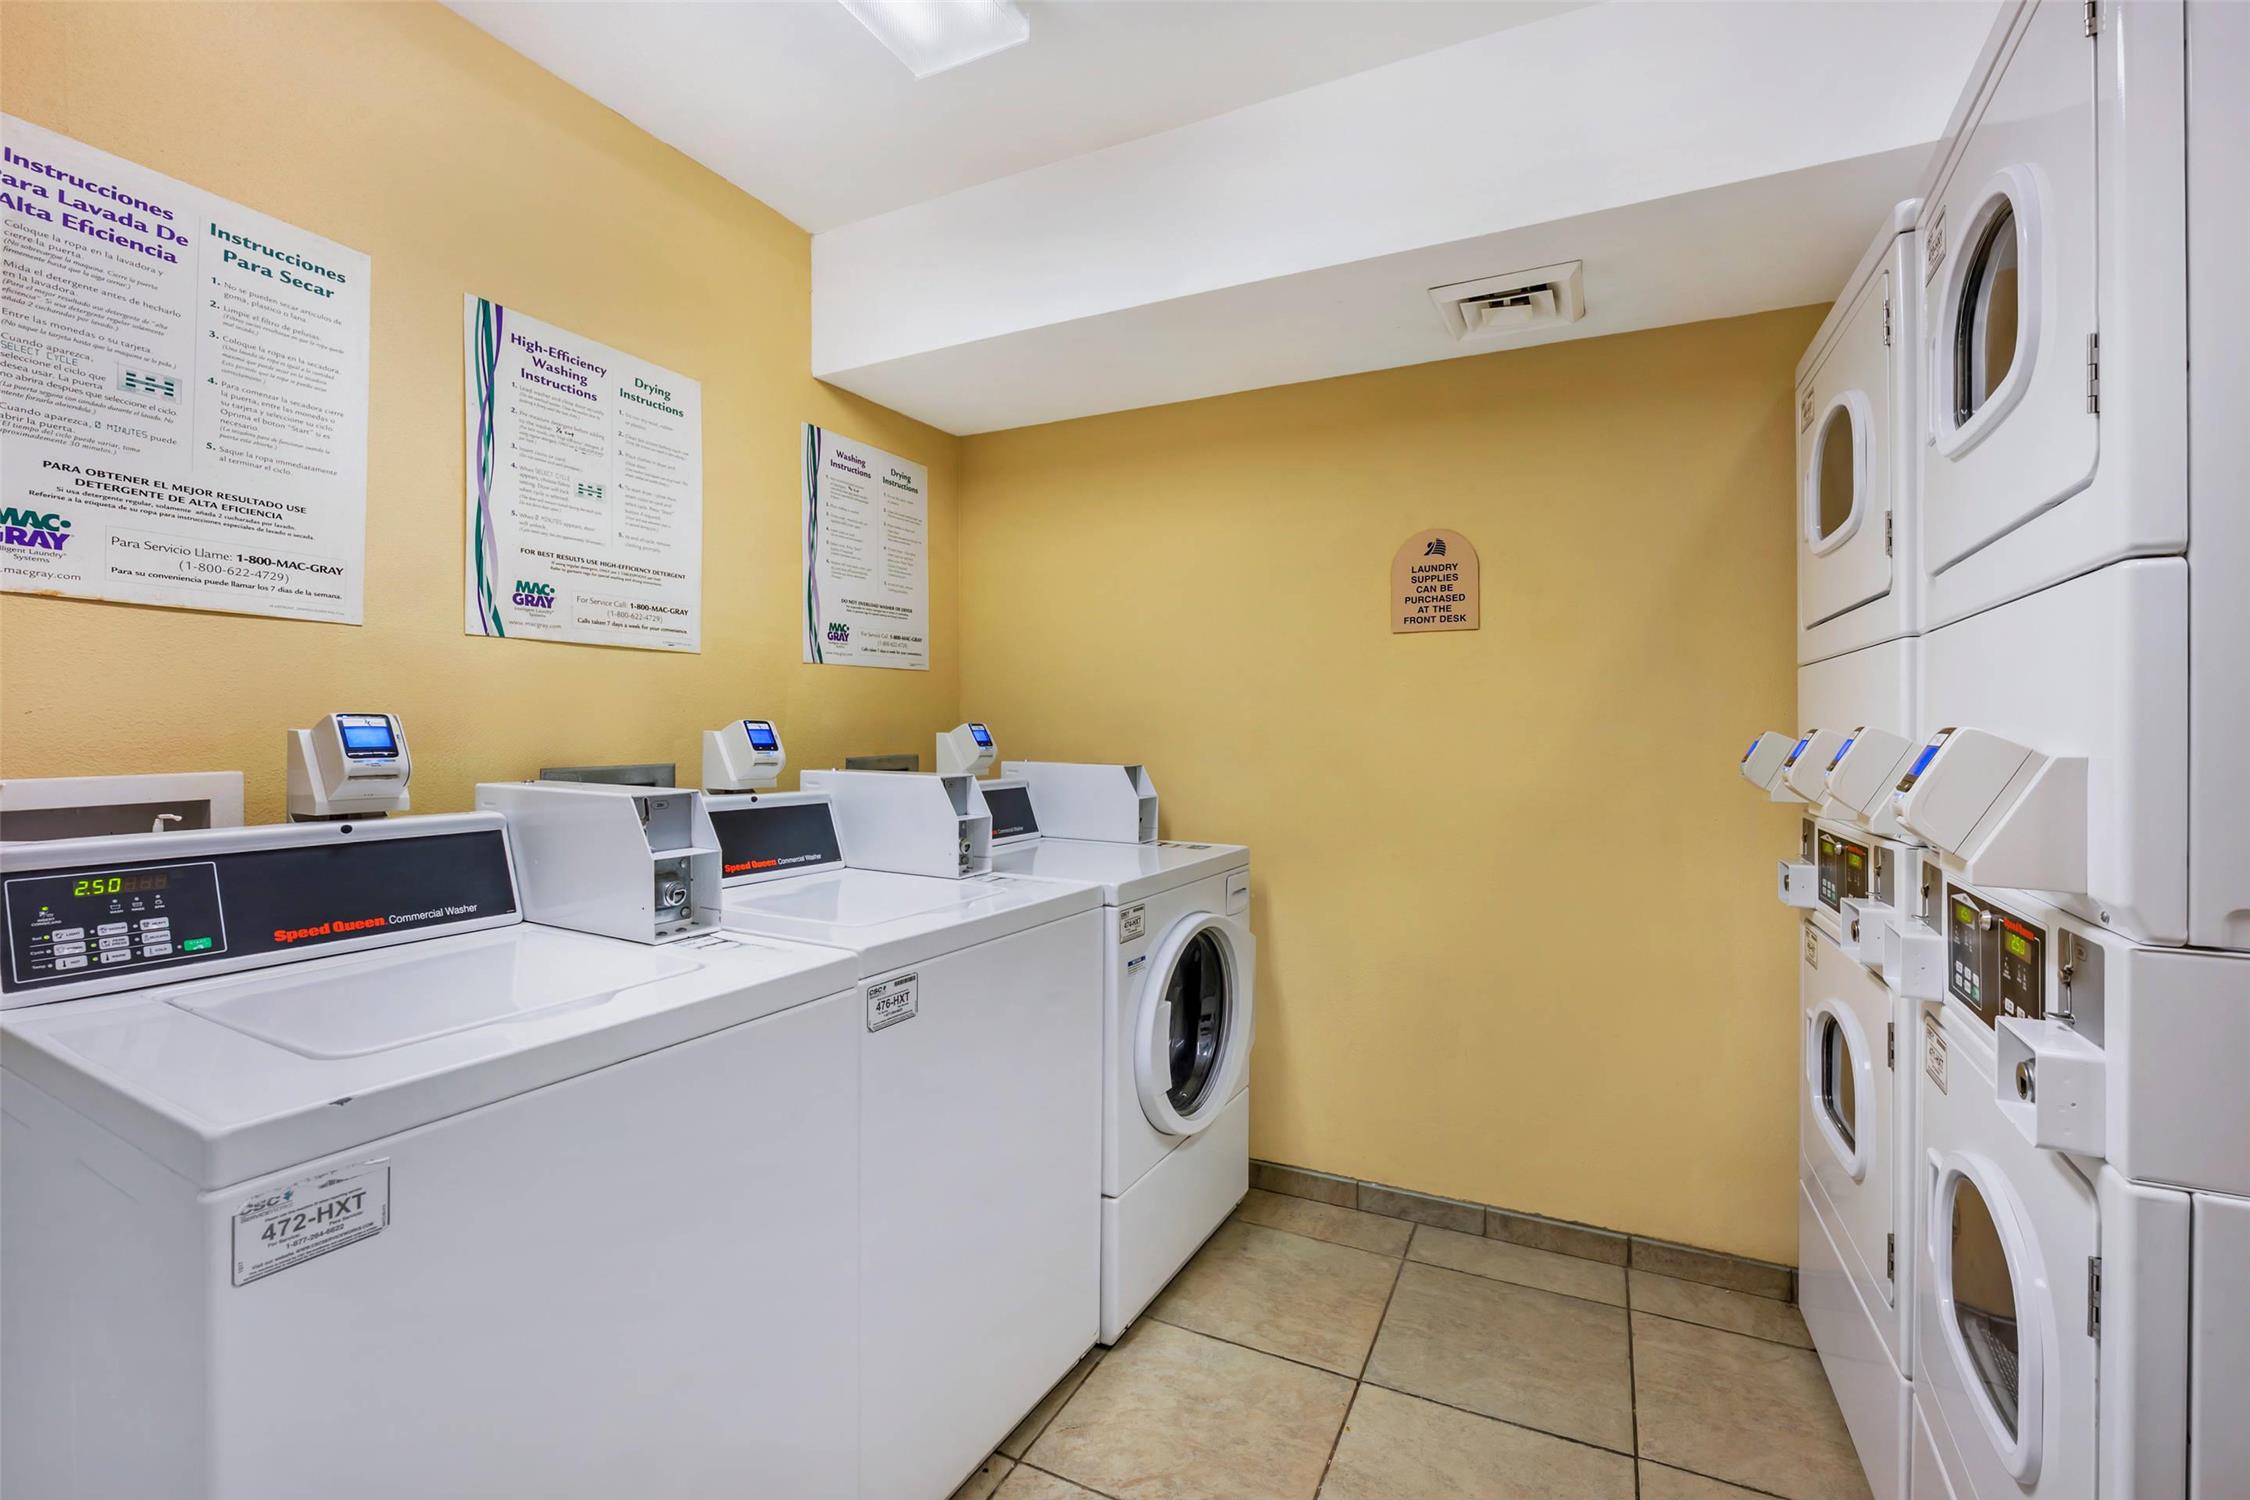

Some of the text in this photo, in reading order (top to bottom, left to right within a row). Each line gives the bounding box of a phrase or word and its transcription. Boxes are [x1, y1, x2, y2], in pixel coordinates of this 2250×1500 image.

[4, 146, 173, 220] Instrucciones
[0, 171, 188, 246] ara Lavada De
[0, 192, 176, 263] Alta Eficiencia
[210, 222, 345, 283] Instrucciones
[211, 276, 220, 285] 1.
[223, 249, 334, 298] Para Secar
[2, 258, 181, 317] Mida el detergente antes de hecharlo
[209, 299, 220, 309] 2.
[208, 330, 219, 339] 3.
[0, 339, 78, 366] SELECT CYCLE
[510, 332, 606, 376] High-Efficiency
[207, 376, 217, 385] 4.
[532, 355, 587, 386] Washing
[520, 367, 597, 401] Instructions
[634, 377, 670, 401] Drying
[619, 387, 683, 417] Instructions
[205, 441, 216, 450] 5.
[830, 458, 871, 478] Instructions
[835, 449, 866, 468] Washing
[42, 460, 305, 513] PARA OBTENER EL MEJOR RESULTADO USE
[882, 476, 918, 494] Instructions
[890, 468, 911, 484] Drying
[74, 478, 282, 520] DETERGENTE DE ALTA EFICIENCIA
[0, 525, 69, 550] RAY
[111, 535, 343, 575] Para Servicio Llame: 1-800-MAC-GRAY
[520, 547, 535, 555] FOR
[536, 550, 554, 558] BEST
[555, 553, 584, 563] RESULTS
[599, 560, 650, 573] HIGH-EFFICIENCY
[651, 569, 685, 579] DETERGENT
[178, 560, 289, 584] (1-800-622-4729)
[1411, 563, 1458, 573] LAUNDRY
[1411, 573, 1458, 583] SUPPLIES
[110, 566, 132, 575] Para
[147, 572, 202, 583] conveniencia
[230, 580, 255, 589] llamar
[256, 583, 268, 591] los
[304, 588, 312, 596] la
[1416, 585, 1437, 593] CAN
[512, 592, 554, 608] GRAY
[630, 602, 688, 615] 1-800-MAC-GRAY
[1404, 593, 1466, 604] PURCHASED
[1432, 604, 1452, 612] THE
[1403, 614, 1466, 624] FRONT DESK
[826, 630, 849, 642] GRAY
[724, 861, 751, 873] Speed
[74, 877, 122, 897] 2.50
[273, 903, 479, 944] Speed Queen Commercial Washer
[876, 991, 910, 1012] 476-HXT
[261, 1191, 367, 1241] 472-HXT
